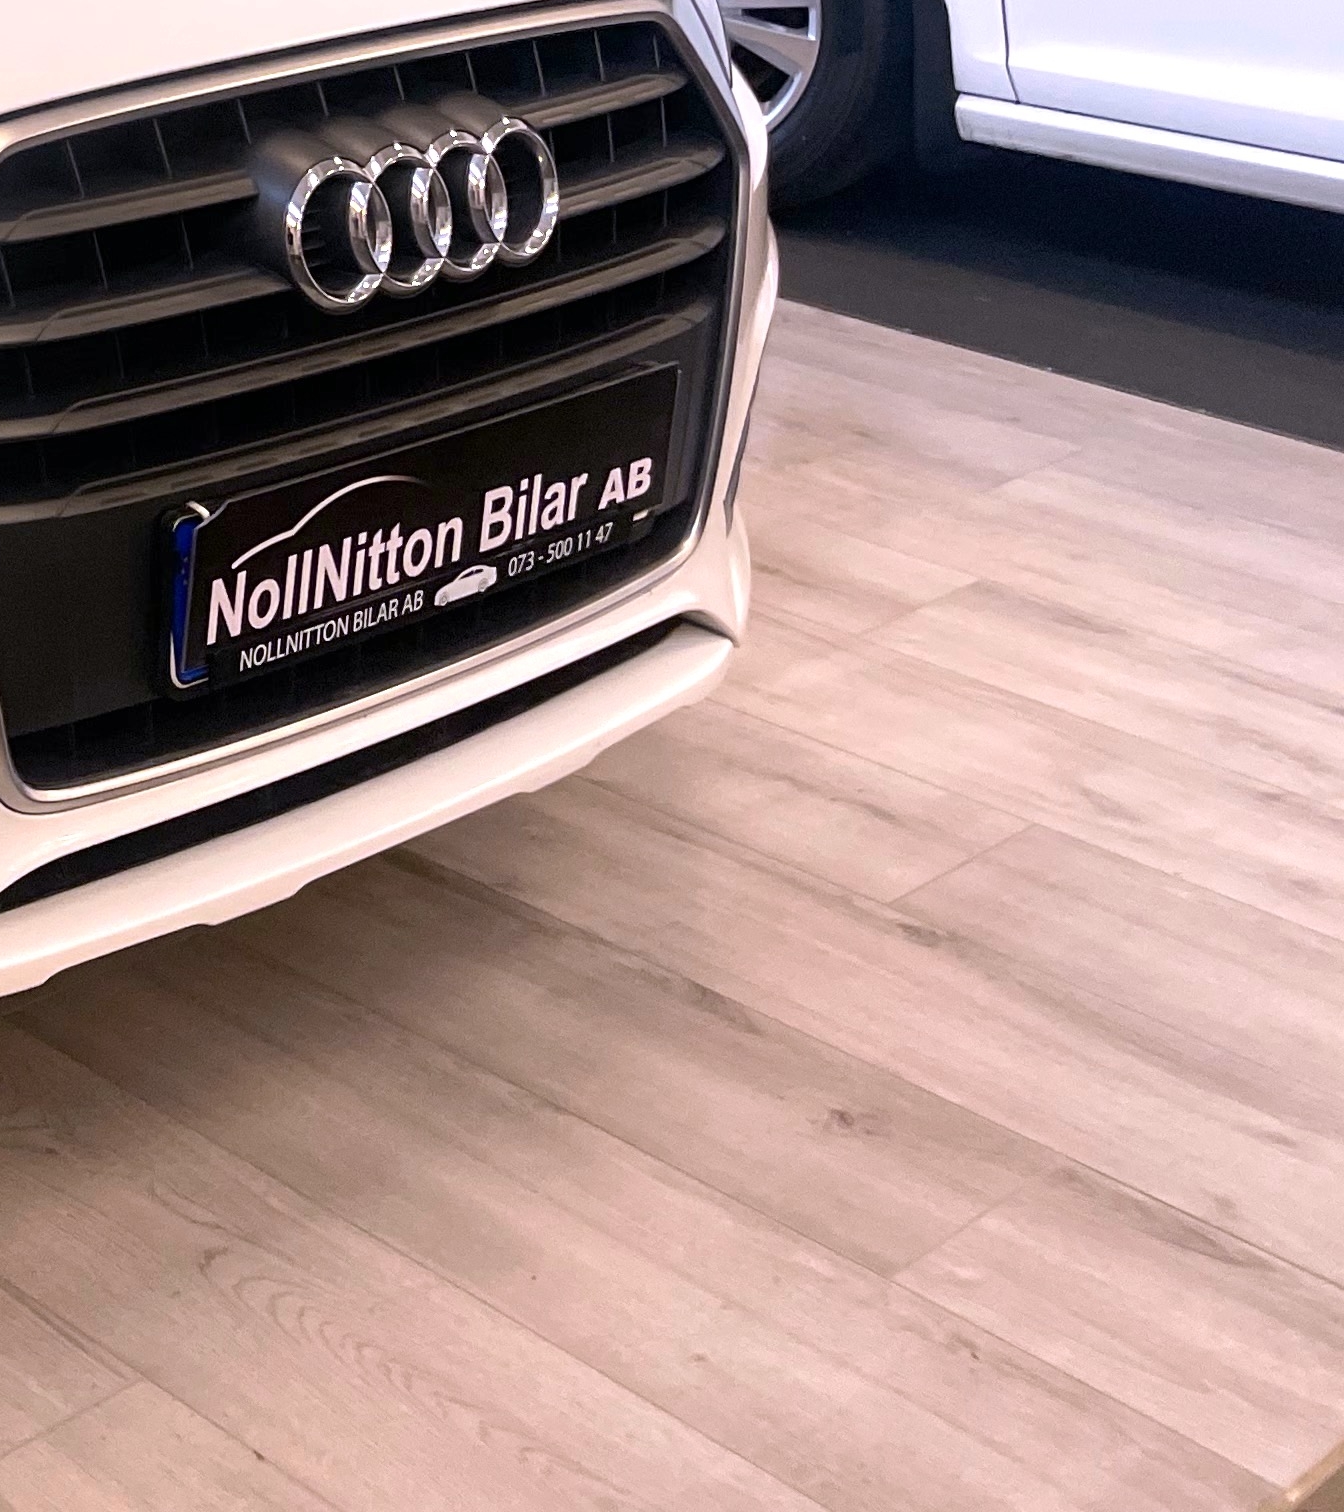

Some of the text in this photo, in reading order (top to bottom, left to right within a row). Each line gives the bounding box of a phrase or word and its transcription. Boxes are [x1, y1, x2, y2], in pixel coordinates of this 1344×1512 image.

[206, 457, 653, 646] NollNitton Bilar AB
[507, 550, 535, 577] 073
[546, 536, 573, 564] 500
[576, 528, 591, 553] 11
[595, 521, 614, 543] 47
[239, 589, 424, 672] NOLLNITTON BILAR AB
